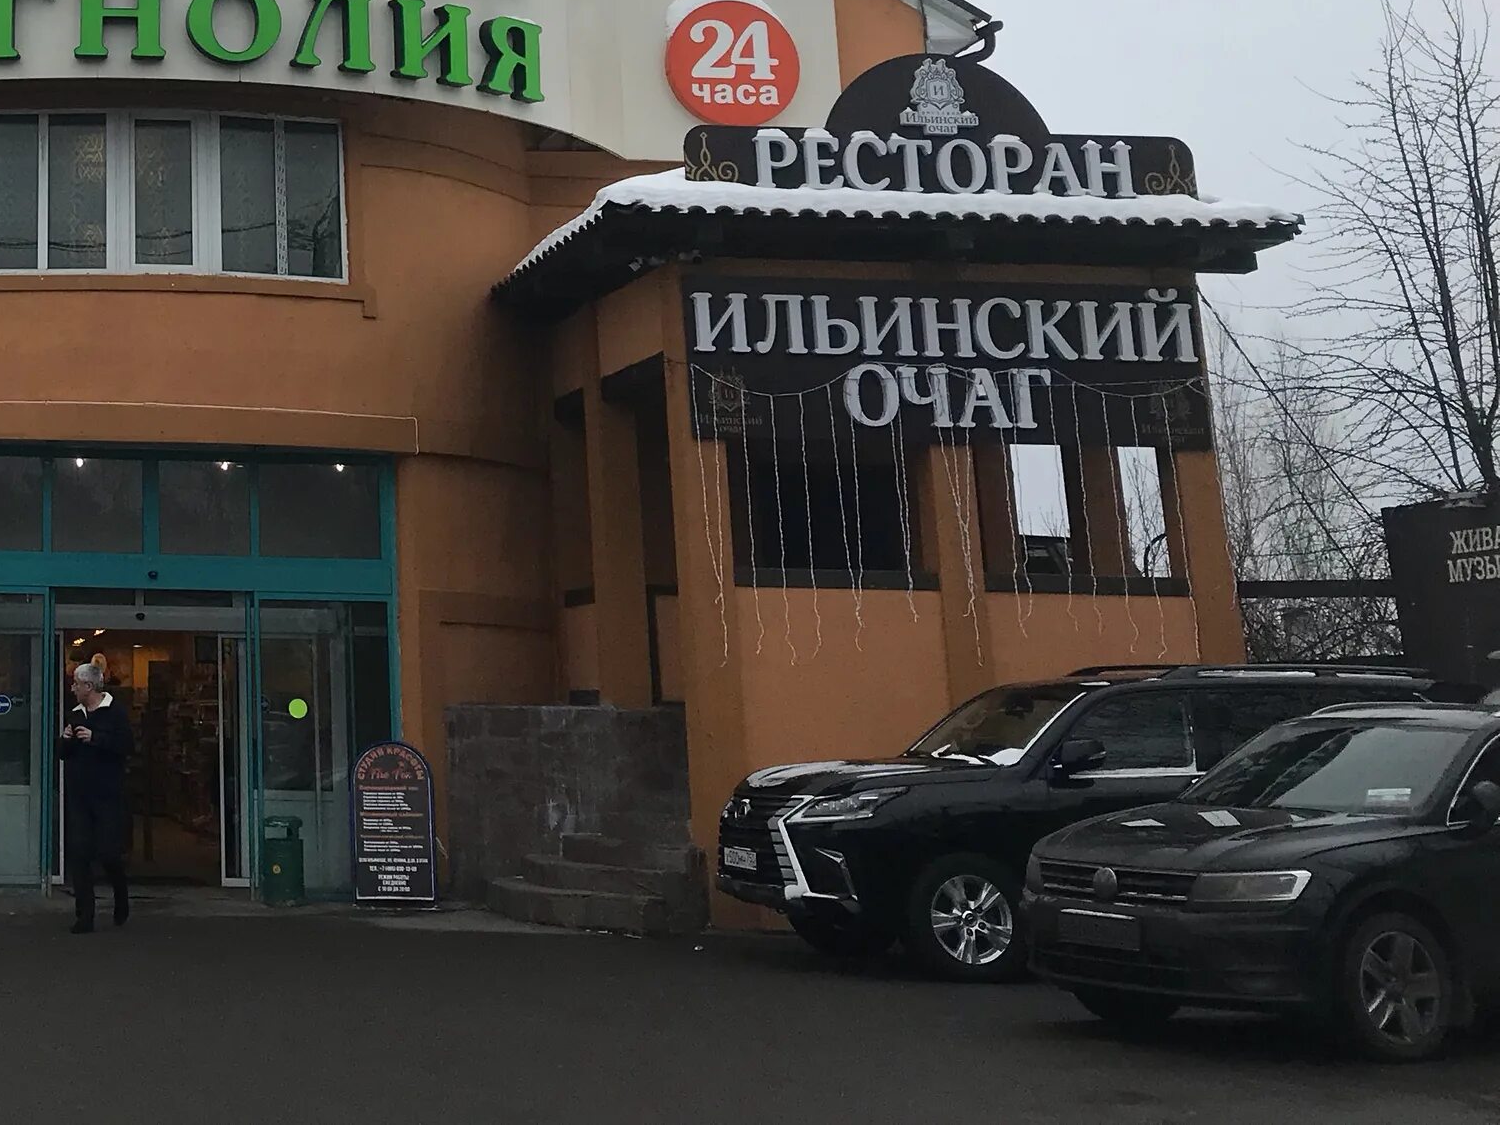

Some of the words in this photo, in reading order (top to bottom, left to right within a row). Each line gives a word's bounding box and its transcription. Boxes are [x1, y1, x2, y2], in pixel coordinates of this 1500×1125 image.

[690, 20, 779, 80] 24
[692, 82, 780, 106] часа
[753, 131, 1134, 198] РЕСТОРАН
[692, 289, 1198, 363] ИЛЬИНСКИЙ
[843, 364, 1050, 429] ОЧАГ
